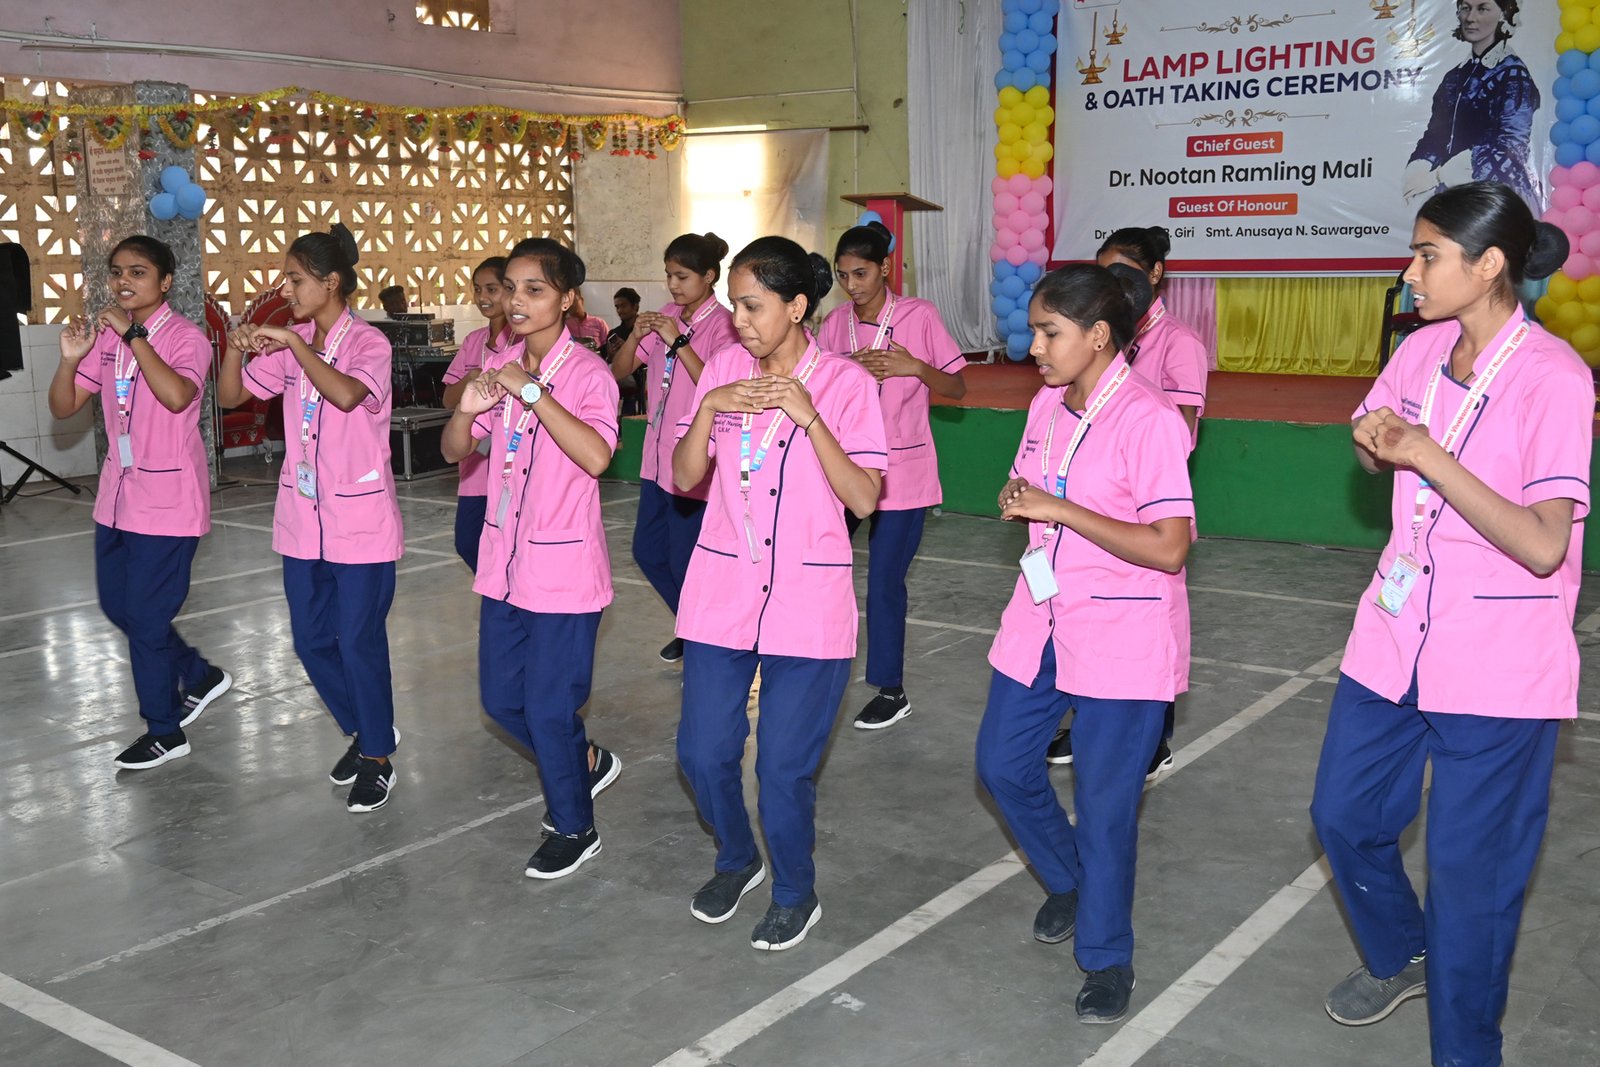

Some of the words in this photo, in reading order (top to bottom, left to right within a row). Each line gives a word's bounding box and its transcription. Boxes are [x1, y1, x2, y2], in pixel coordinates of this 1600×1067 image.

[1123, 52, 1208, 82] LAMP
[1216, 36, 1375, 74] LIGHTING
[1084, 91, 1098, 110] &
[1104, 84, 1164, 109] OATH
[1170, 78, 1260, 104] TAKING
[1267, 66, 1423, 96] CEREMONY
[1194, 140, 1230, 153] Chief
[1233, 138, 1275, 152] Guest
[1109, 170, 1134, 187] Dr.
[1140, 166, 1216, 186] Nootan
[1222, 161, 1315, 186] Ramling
[1323, 158, 1372, 179] Mali
[1176, 201, 1214, 213] Guest
[1217, 201, 1234, 212] Of
[1238, 199, 1288, 212] Honour
[1095, 229, 1108, 240] Dr.
[1175, 227, 1194, 238] Giri
[1206, 227, 1233, 238] Smt.
[1236, 226, 1292, 240] Anusaya
[1296, 225, 1308, 236] N.
[1311, 224, 1390, 238] Sawargave
[550, 356, 564, 372] Nursing
[799, 364, 813, 381] Nursing
[1451, 396, 1475, 433] Vivekanand
[1472, 375, 1489, 396] School
[1492, 344, 1513, 369] Nursing
[1060, 452, 1071, 471] Swami
[1083, 403, 1098, 420] School
[1101, 379, 1118, 399] Nursing
